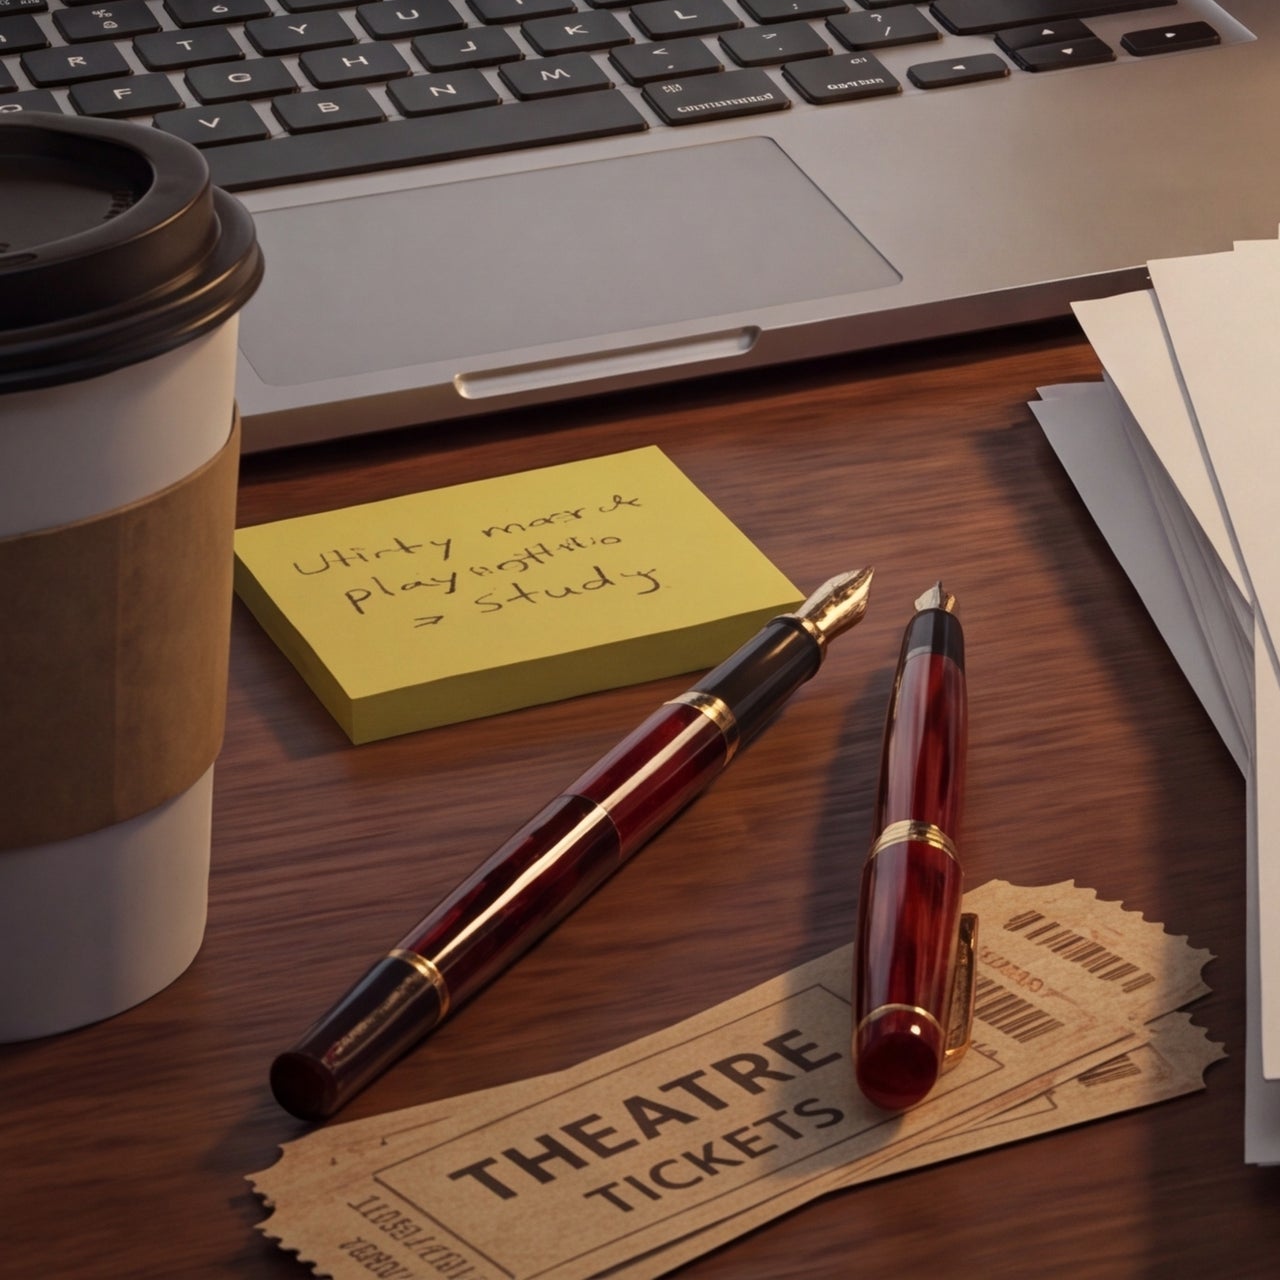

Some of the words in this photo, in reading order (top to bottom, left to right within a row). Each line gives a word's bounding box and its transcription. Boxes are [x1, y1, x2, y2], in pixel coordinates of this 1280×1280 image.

[396, 9, 419, 20] U
[674, 10, 697, 21] L
[289, 23, 308, 35] Y
[565, 24, 587, 35] K
[177, 41, 193, 51] T
[68, 56, 86, 68] R
[342, 56, 368, 68] H
[540, 68, 571, 81] M
[113, 88, 132, 100] F
[430, 84, 457, 97] N
[318, 102, 340, 113] B
[199, 117, 220, 129] V
[448, 1029, 842, 1201] THEATRE
[584, 1097, 844, 1213] TICKETS
